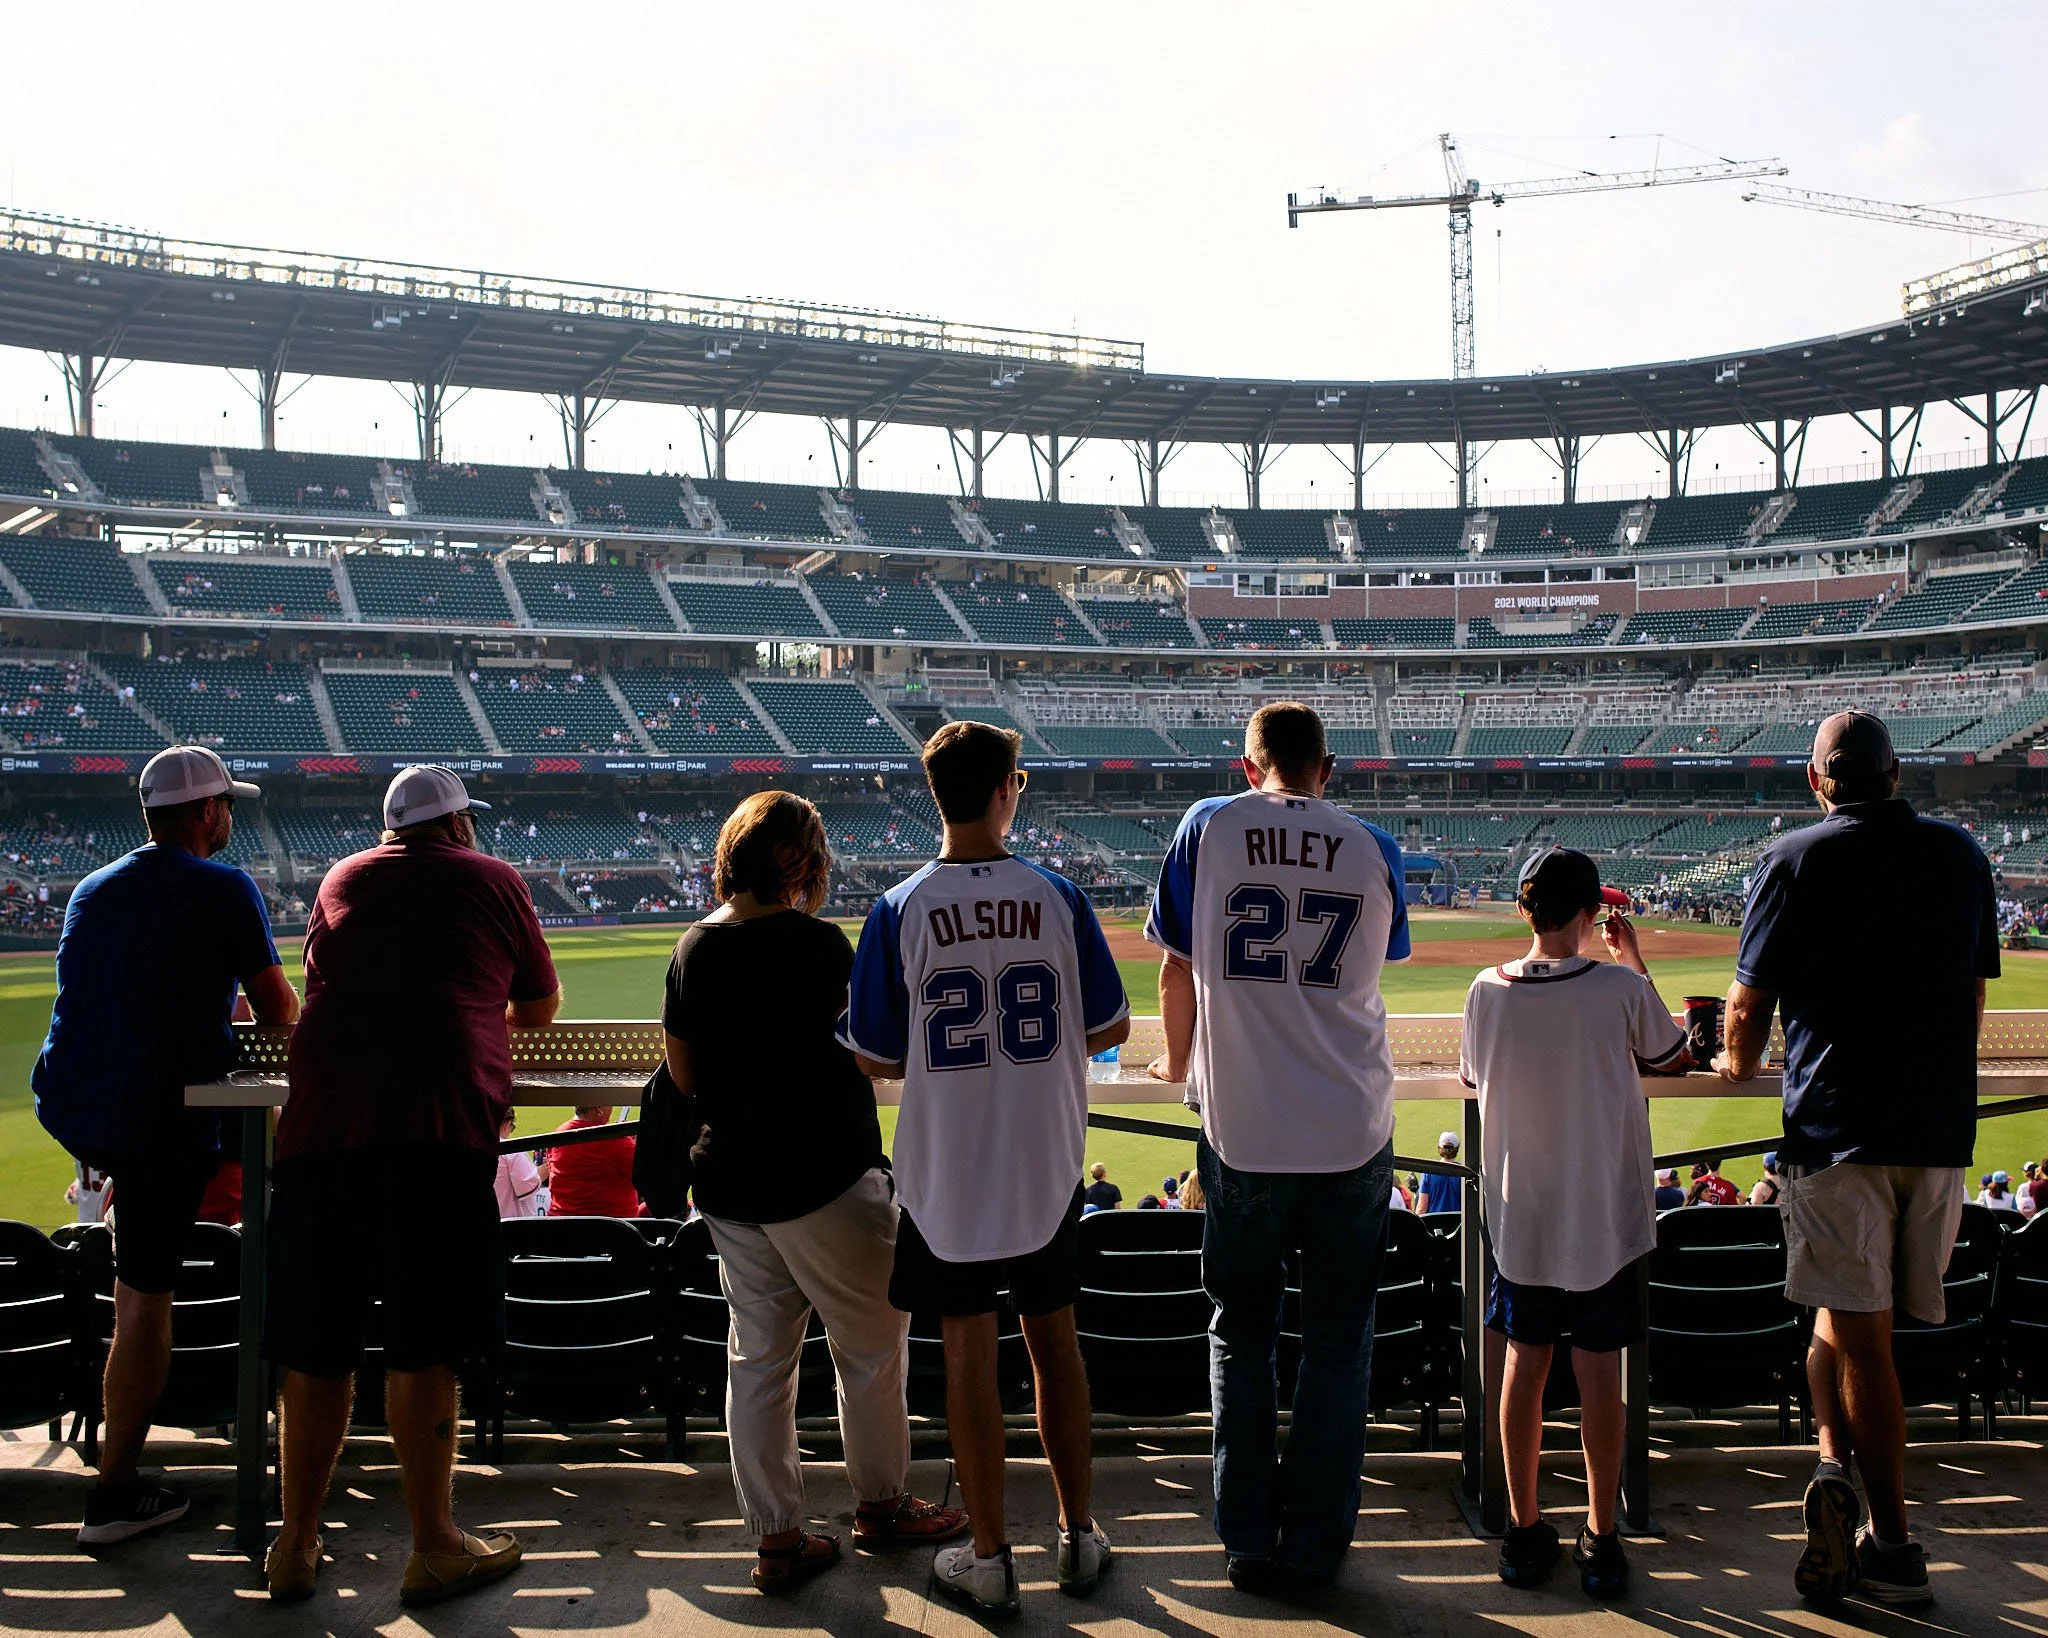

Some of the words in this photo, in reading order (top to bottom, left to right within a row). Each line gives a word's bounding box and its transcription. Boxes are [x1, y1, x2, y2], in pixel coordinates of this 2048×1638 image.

[1494, 597, 1516, 609] 2021
[1517, 596, 1547, 608] WORLD
[1549, 594, 1600, 607] CHAMPIONS
[15, 760, 40, 768] PARK
[246, 761, 269, 769] PARK
[1245, 827, 1345, 873] RILEY
[928, 899, 1042, 948] OLSON
[1223, 882, 1365, 990] 27
[921, 959, 1062, 1073] 28
[1686, 1021, 1705, 1047] A
